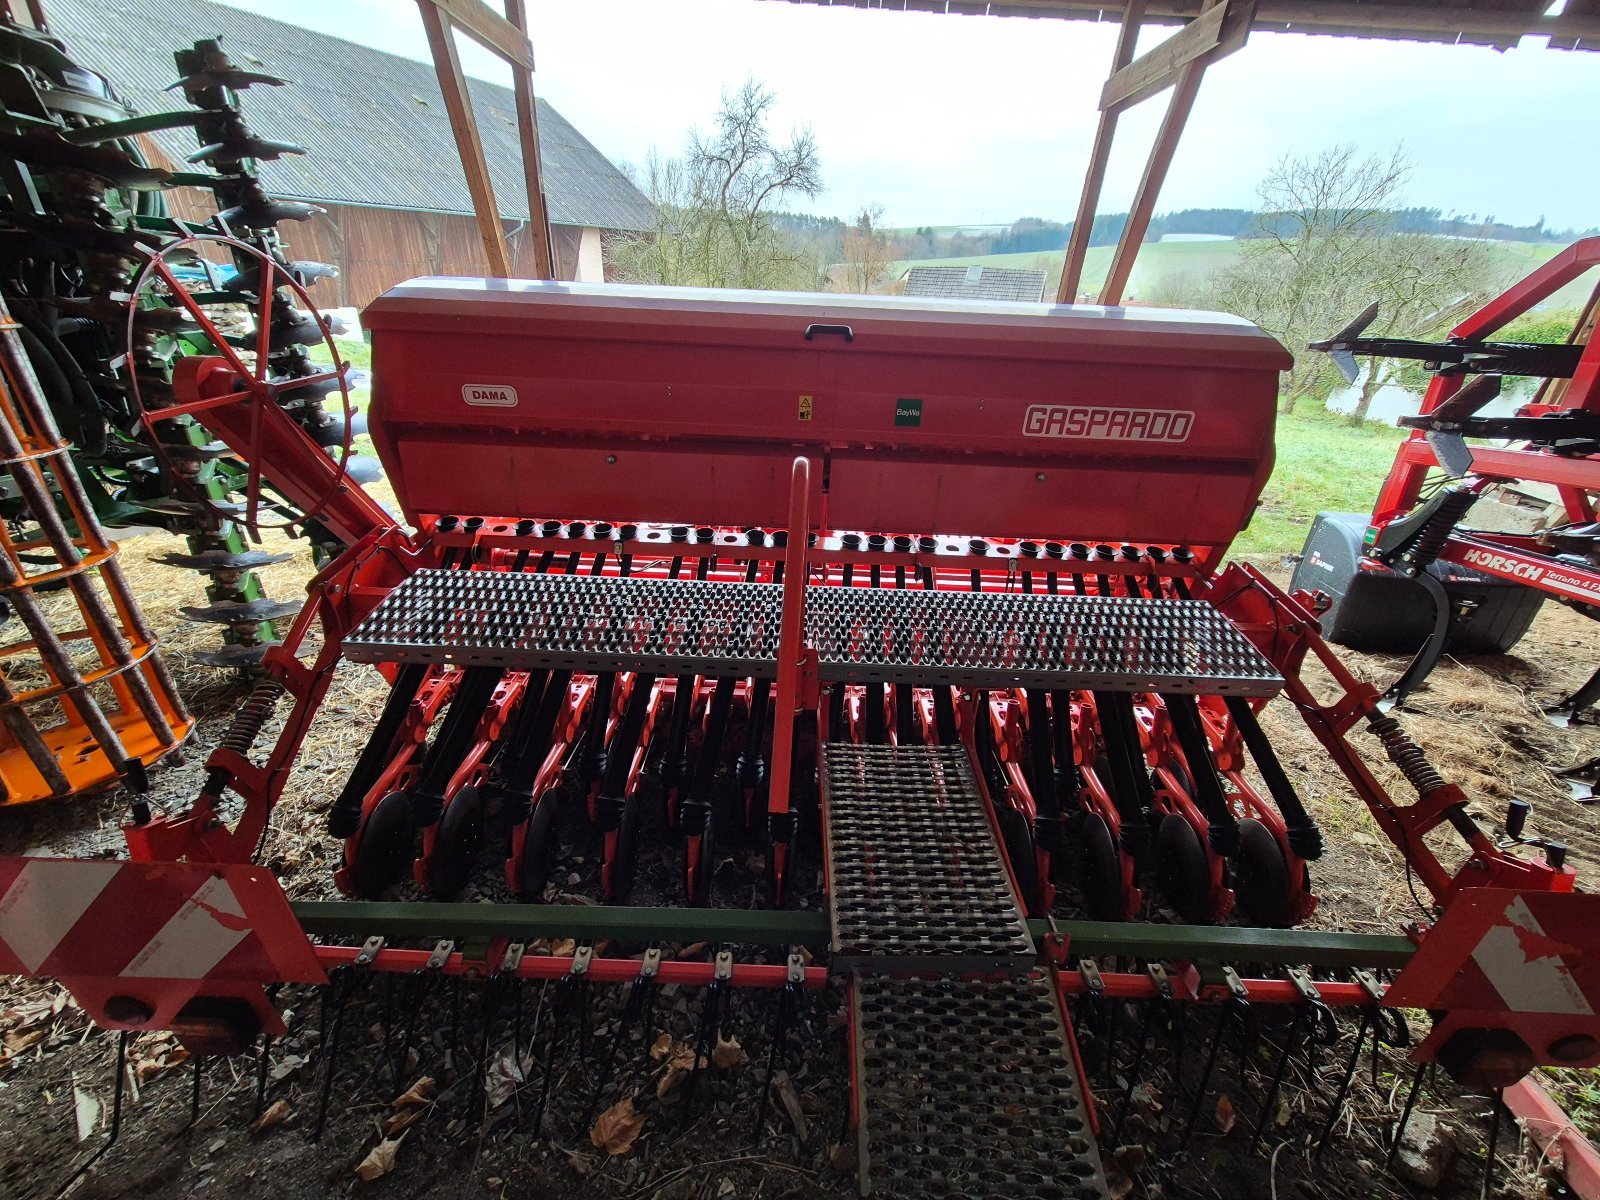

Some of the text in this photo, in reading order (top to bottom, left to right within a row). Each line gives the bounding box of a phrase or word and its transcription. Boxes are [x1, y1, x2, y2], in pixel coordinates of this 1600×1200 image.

[472, 390, 508, 401] DAMA
[896, 408, 920, 417] BayWa
[1024, 407, 1191, 440] GASPARDO
[1463, 549, 1544, 581] HORSCH
[1546, 569, 1580, 586] Terrano
[1581, 580, 1591, 588] 4
